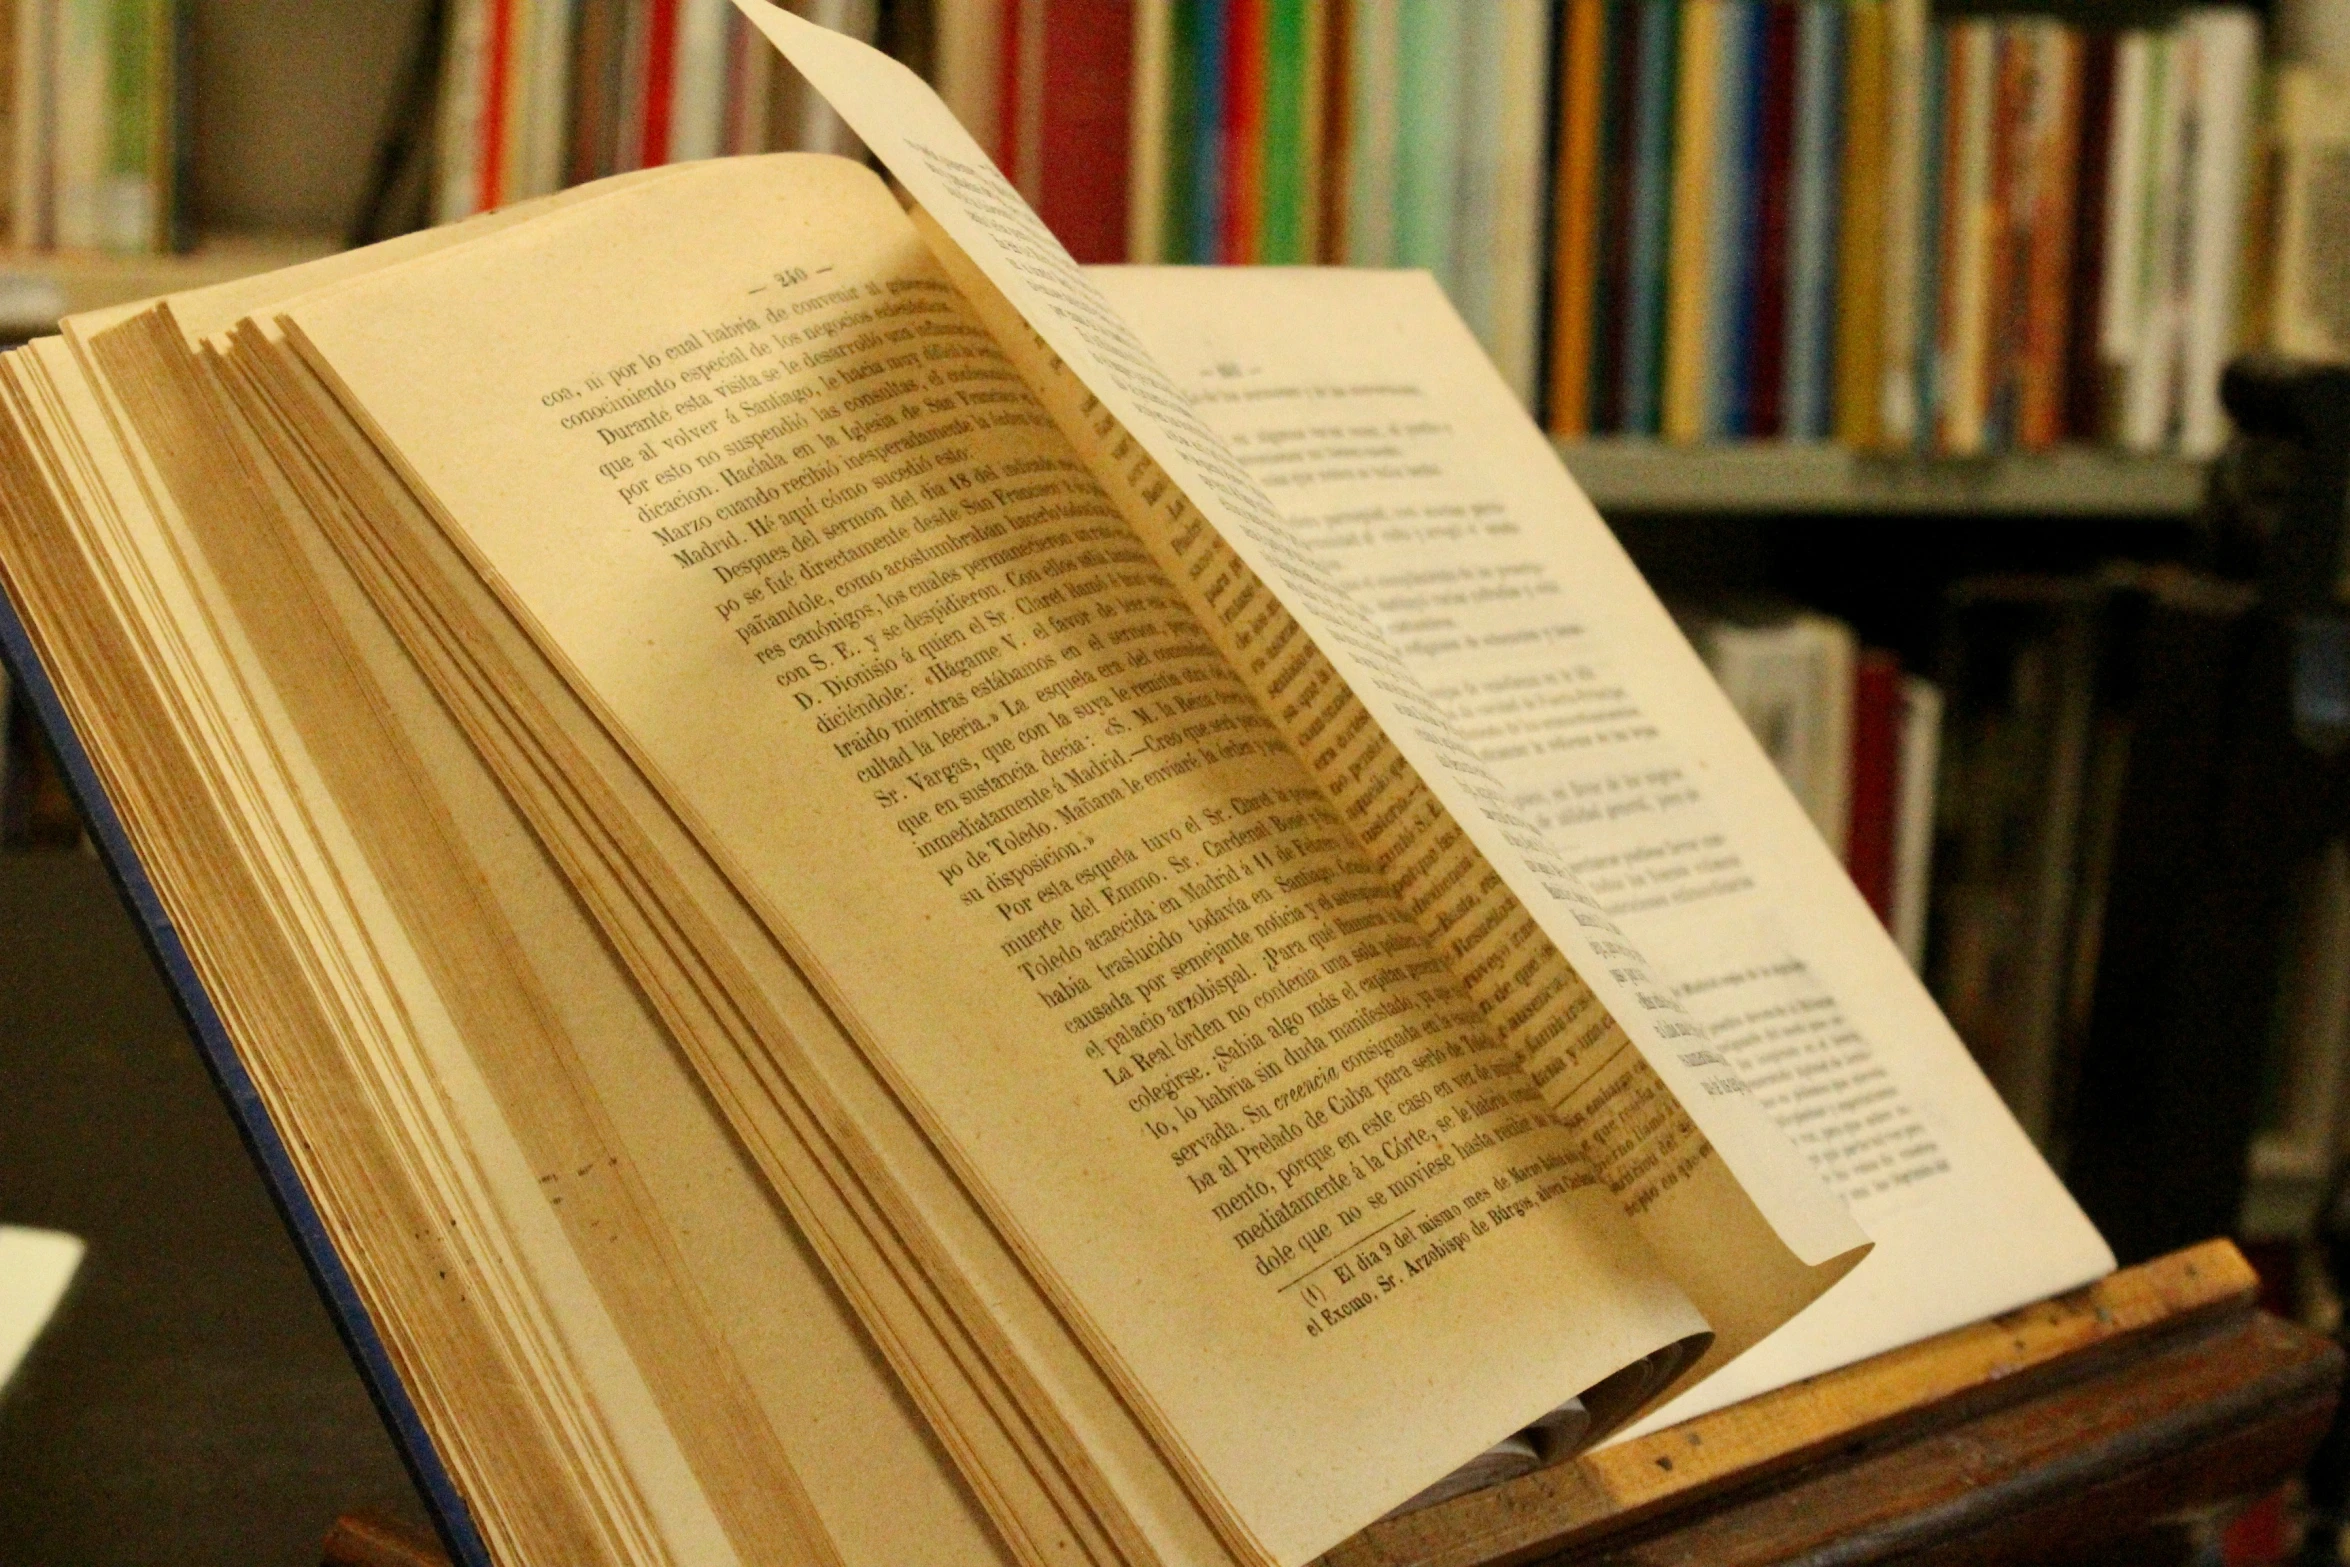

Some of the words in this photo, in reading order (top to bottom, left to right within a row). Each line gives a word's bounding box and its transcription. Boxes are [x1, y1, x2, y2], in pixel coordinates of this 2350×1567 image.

[560, 379, 677, 429] conocimiento
[680, 347, 749, 383] especial
[772, 334, 801, 349] los
[803, 312, 873, 340] negocios
[608, 362, 638, 387] por
[665, 333, 703, 360] cual
[792, 287, 859, 314] convenir
[596, 410, 669, 446] Durante
[675, 394, 713, 415] esta
[714, 375, 762, 398] visita
[598, 456, 634, 480] que
[661, 420, 718, 449] volver
[739, 387, 822, 418] Santiago,
[617, 479, 650, 506] por
[655, 463, 693, 485] esto
[725, 412, 809, 453] suspendió
[810, 405, 842, 422] las
[637, 486, 719, 523] dicacion.
[719, 452, 789, 487] Hacíala
[839, 413, 899, 442] Iglesia
[651, 516, 713, 547] Marzo
[715, 486, 781, 520] cuando
[780, 459, 840, 495] recibió
[671, 529, 748, 570] Madrid.
[745, 514, 776, 538] Hé
[777, 496, 819, 527] aquí
[820, 482, 868, 509] cómo
[871, 454, 933, 490] sucedió
[712, 545, 791, 585] Despues
[791, 528, 821, 553] del
[821, 505, 889, 541] sermon
[890, 489, 919, 511] del
[734, 592, 835, 646] pañandole,
[834, 570, 884, 598] como
[883, 522, 1008, 577] acostumbraban
[763, 569, 798, 595] fué
[799, 527, 910, 581] directamente
[912, 507, 959, 533] desde
[753, 643, 787, 665] res
[788, 604, 883, 650] canónigos,
[875, 589, 909, 609] los
[908, 568, 962, 597] cuales
[775, 665, 812, 687] con
[807, 652, 835, 672] S.
[831, 640, 862, 661] E.
[902, 584, 1006, 631] despidieron.
[1004, 568, 1043, 588] Con
[792, 691, 822, 711] D.
[819, 658, 899, 698] Dionisio
[917, 629, 967, 661] quien
[983, 607, 1015, 628] Sr.
[1014, 587, 1068, 615] Claret
[816, 683, 915, 734] diciéndole:
[999, 632, 1027, 651] V.
[1047, 609, 1092, 634] favor
[832, 725, 891, 759] traido
[890, 692, 969, 735] mientras
[970, 654, 1057, 699] estábamos
[856, 745, 915, 784] cultad
[999, 698, 1030, 718] La
[1035, 668, 1098, 703] esquela
[1096, 660, 1126, 678] era
[873, 788, 908, 809] Sr.
[905, 757, 981, 792] Vargas,
[980, 737, 1016, 765] que
[1017, 722, 1051, 745] con
[1072, 695, 1114, 720] suya
[897, 811, 929, 837] que
[958, 760, 1040, 806] sustancia
[916, 787, 1054, 859] inmediatamente
[985, 821, 1058, 857] Toledo.
[1054, 787, 1126, 826] Mañana
[1143, 751, 1202, 786] enviaré
[994, 897, 1033, 922] Por
[1036, 879, 1075, 904] esta
[1074, 847, 1139, 885] esquela
[1140, 827, 1183, 853] tuvo
[1202, 807, 1233, 826] Sr.
[1000, 917, 1063, 958] muerte
[1069, 896, 1101, 923] del
[1099, 871, 1168, 907] Emmo.
[1167, 855, 1200, 875] Sr.
[1201, 820, 1273, 858] Cardenal
[1016, 944, 1083, 982] Toledo
[1084, 907, 1159, 952] acaecida
[1178, 863, 1242, 904] Madrid
[1064, 991, 1136, 1034] causada
[1134, 973, 1168, 1004] por
[1170, 931, 1254, 981] semejante
[1253, 906, 1307, 939] noticia
[1095, 930, 1184, 981] traslucido
[1187, 896, 1252, 934] todavía
[1101, 1065, 1135, 1088] La
[1129, 1039, 1176, 1073] Real
[1172, 1017, 1227, 1052] órden
[1320, 954, 1353, 975] una
[1103, 1012, 1166, 1056] palacio
[1165, 962, 1258, 1019] arzobispal.
[1262, 940, 1308, 973] ¿Para
[1307, 922, 1337, 952] qué
[1127, 1066, 1211, 1113] colegirse.
[1266, 1012, 1305, 1040] algo
[1305, 991, 1341, 1019] más
[1170, 1121, 1246, 1168] servada.
[1241, 1104, 1273, 1125] Su
[1273, 1065, 1340, 1111] creencia
[1340, 1024, 1423, 1073] consignada
[1254, 1061, 1284, 1084] sin
[1283, 1035, 1329, 1067] duda
[1210, 1180, 1278, 1222] mento,
[1275, 1144, 1336, 1190] porque
[1361, 1109, 1396, 1136] este
[1396, 1090, 1433, 1116] caso
[1233, 1123, 1304, 1167] Prelado
[1326, 1084, 1375, 1116] Cuba
[1373, 1064, 1413, 1096] para
[1232, 1173, 1352, 1250] mediatamente
[1381, 1128, 1443, 1161] Córte,
[1254, 1244, 1296, 1277] dole
[1297, 1222, 1333, 1255] que
[1386, 1152, 1456, 1198] moviese
[1450, 1132, 1497, 1161] hasta
[1332, 1262, 1357, 1286] El
[1378, 1240, 1393, 1258] 9
[1392, 1225, 1418, 1249] del
[1416, 1204, 1462, 1236] mismo
[1462, 1187, 1492, 1210] mes
[1319, 1291, 1379, 1327] Excmo.
[1376, 1273, 1404, 1295] Sr.
[1402, 1231, 1471, 1279] Arzobispo
